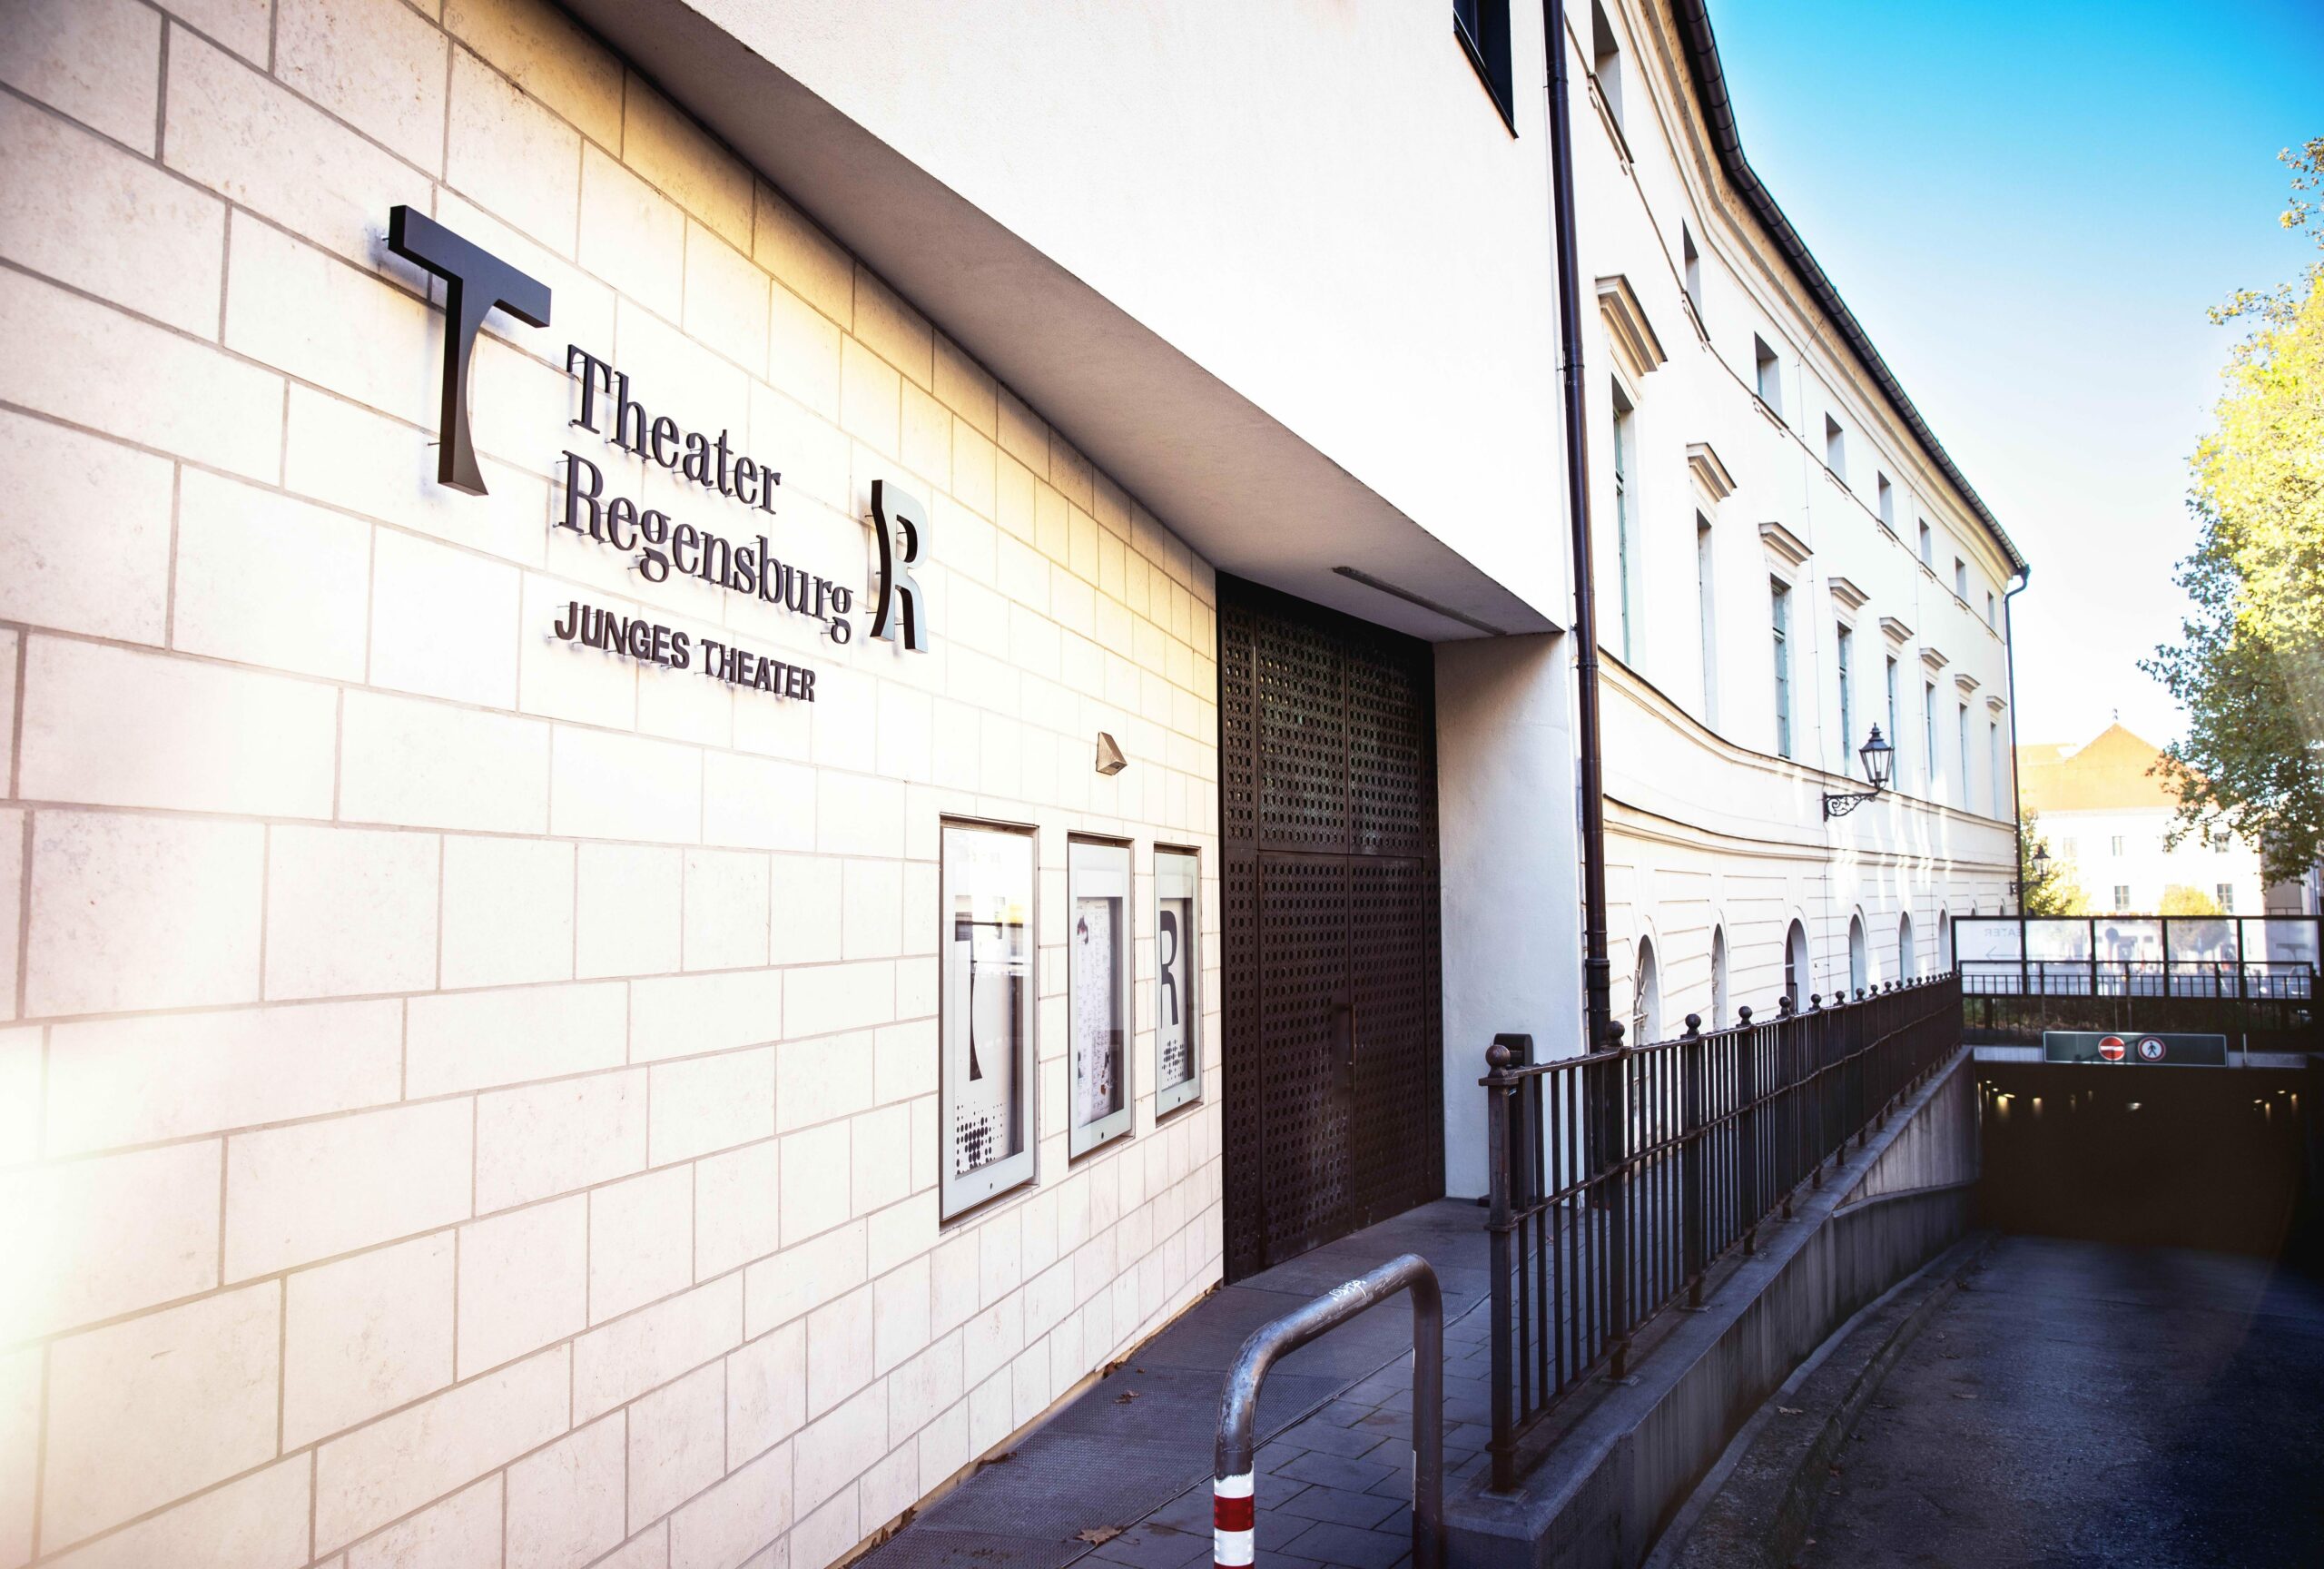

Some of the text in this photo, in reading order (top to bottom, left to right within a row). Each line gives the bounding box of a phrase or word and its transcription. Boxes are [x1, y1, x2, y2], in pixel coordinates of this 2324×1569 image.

[389, 205, 551, 497] T
[566, 344, 782, 515] Theater
[558, 450, 853, 645] Regensburg
[871, 479, 928, 653] R
[554, 601, 816, 703] JUNGES THEATER
